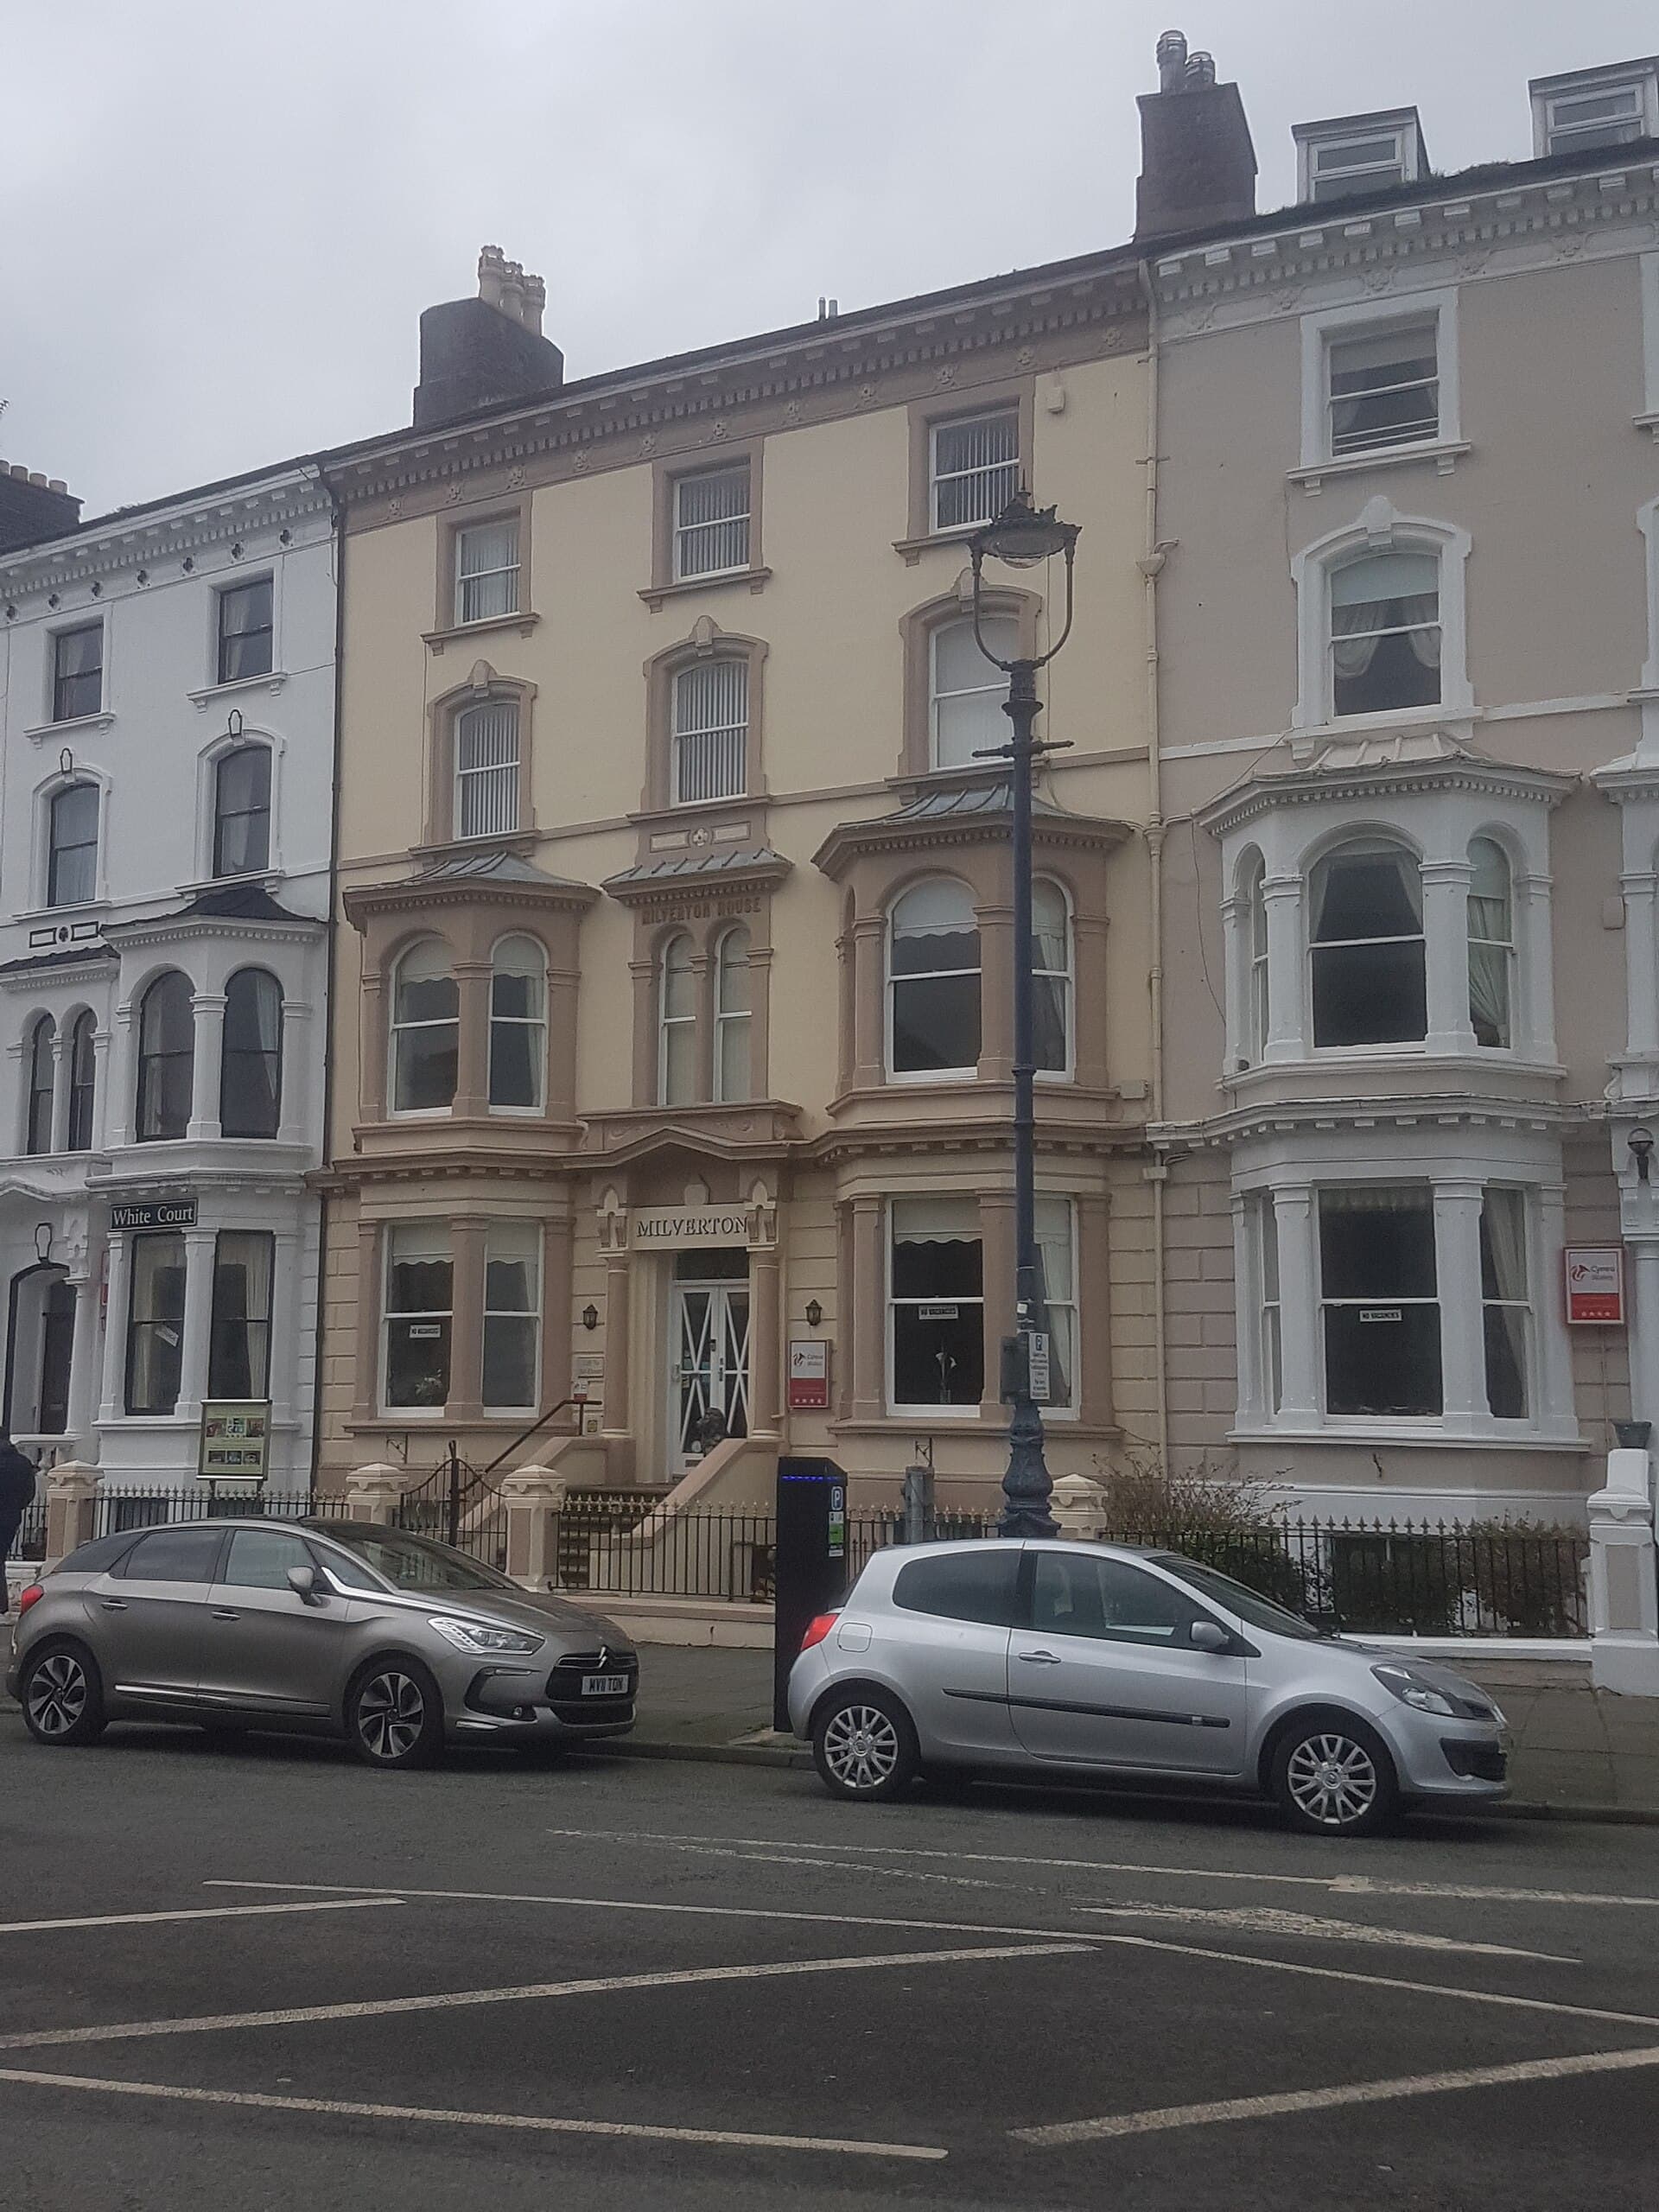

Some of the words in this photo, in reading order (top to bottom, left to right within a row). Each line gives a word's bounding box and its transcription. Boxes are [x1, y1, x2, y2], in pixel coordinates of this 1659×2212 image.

[113, 1208, 151, 1225] White
[157, 1205, 194, 1223] Court
[636, 1216, 748, 1237] MILVERTON
